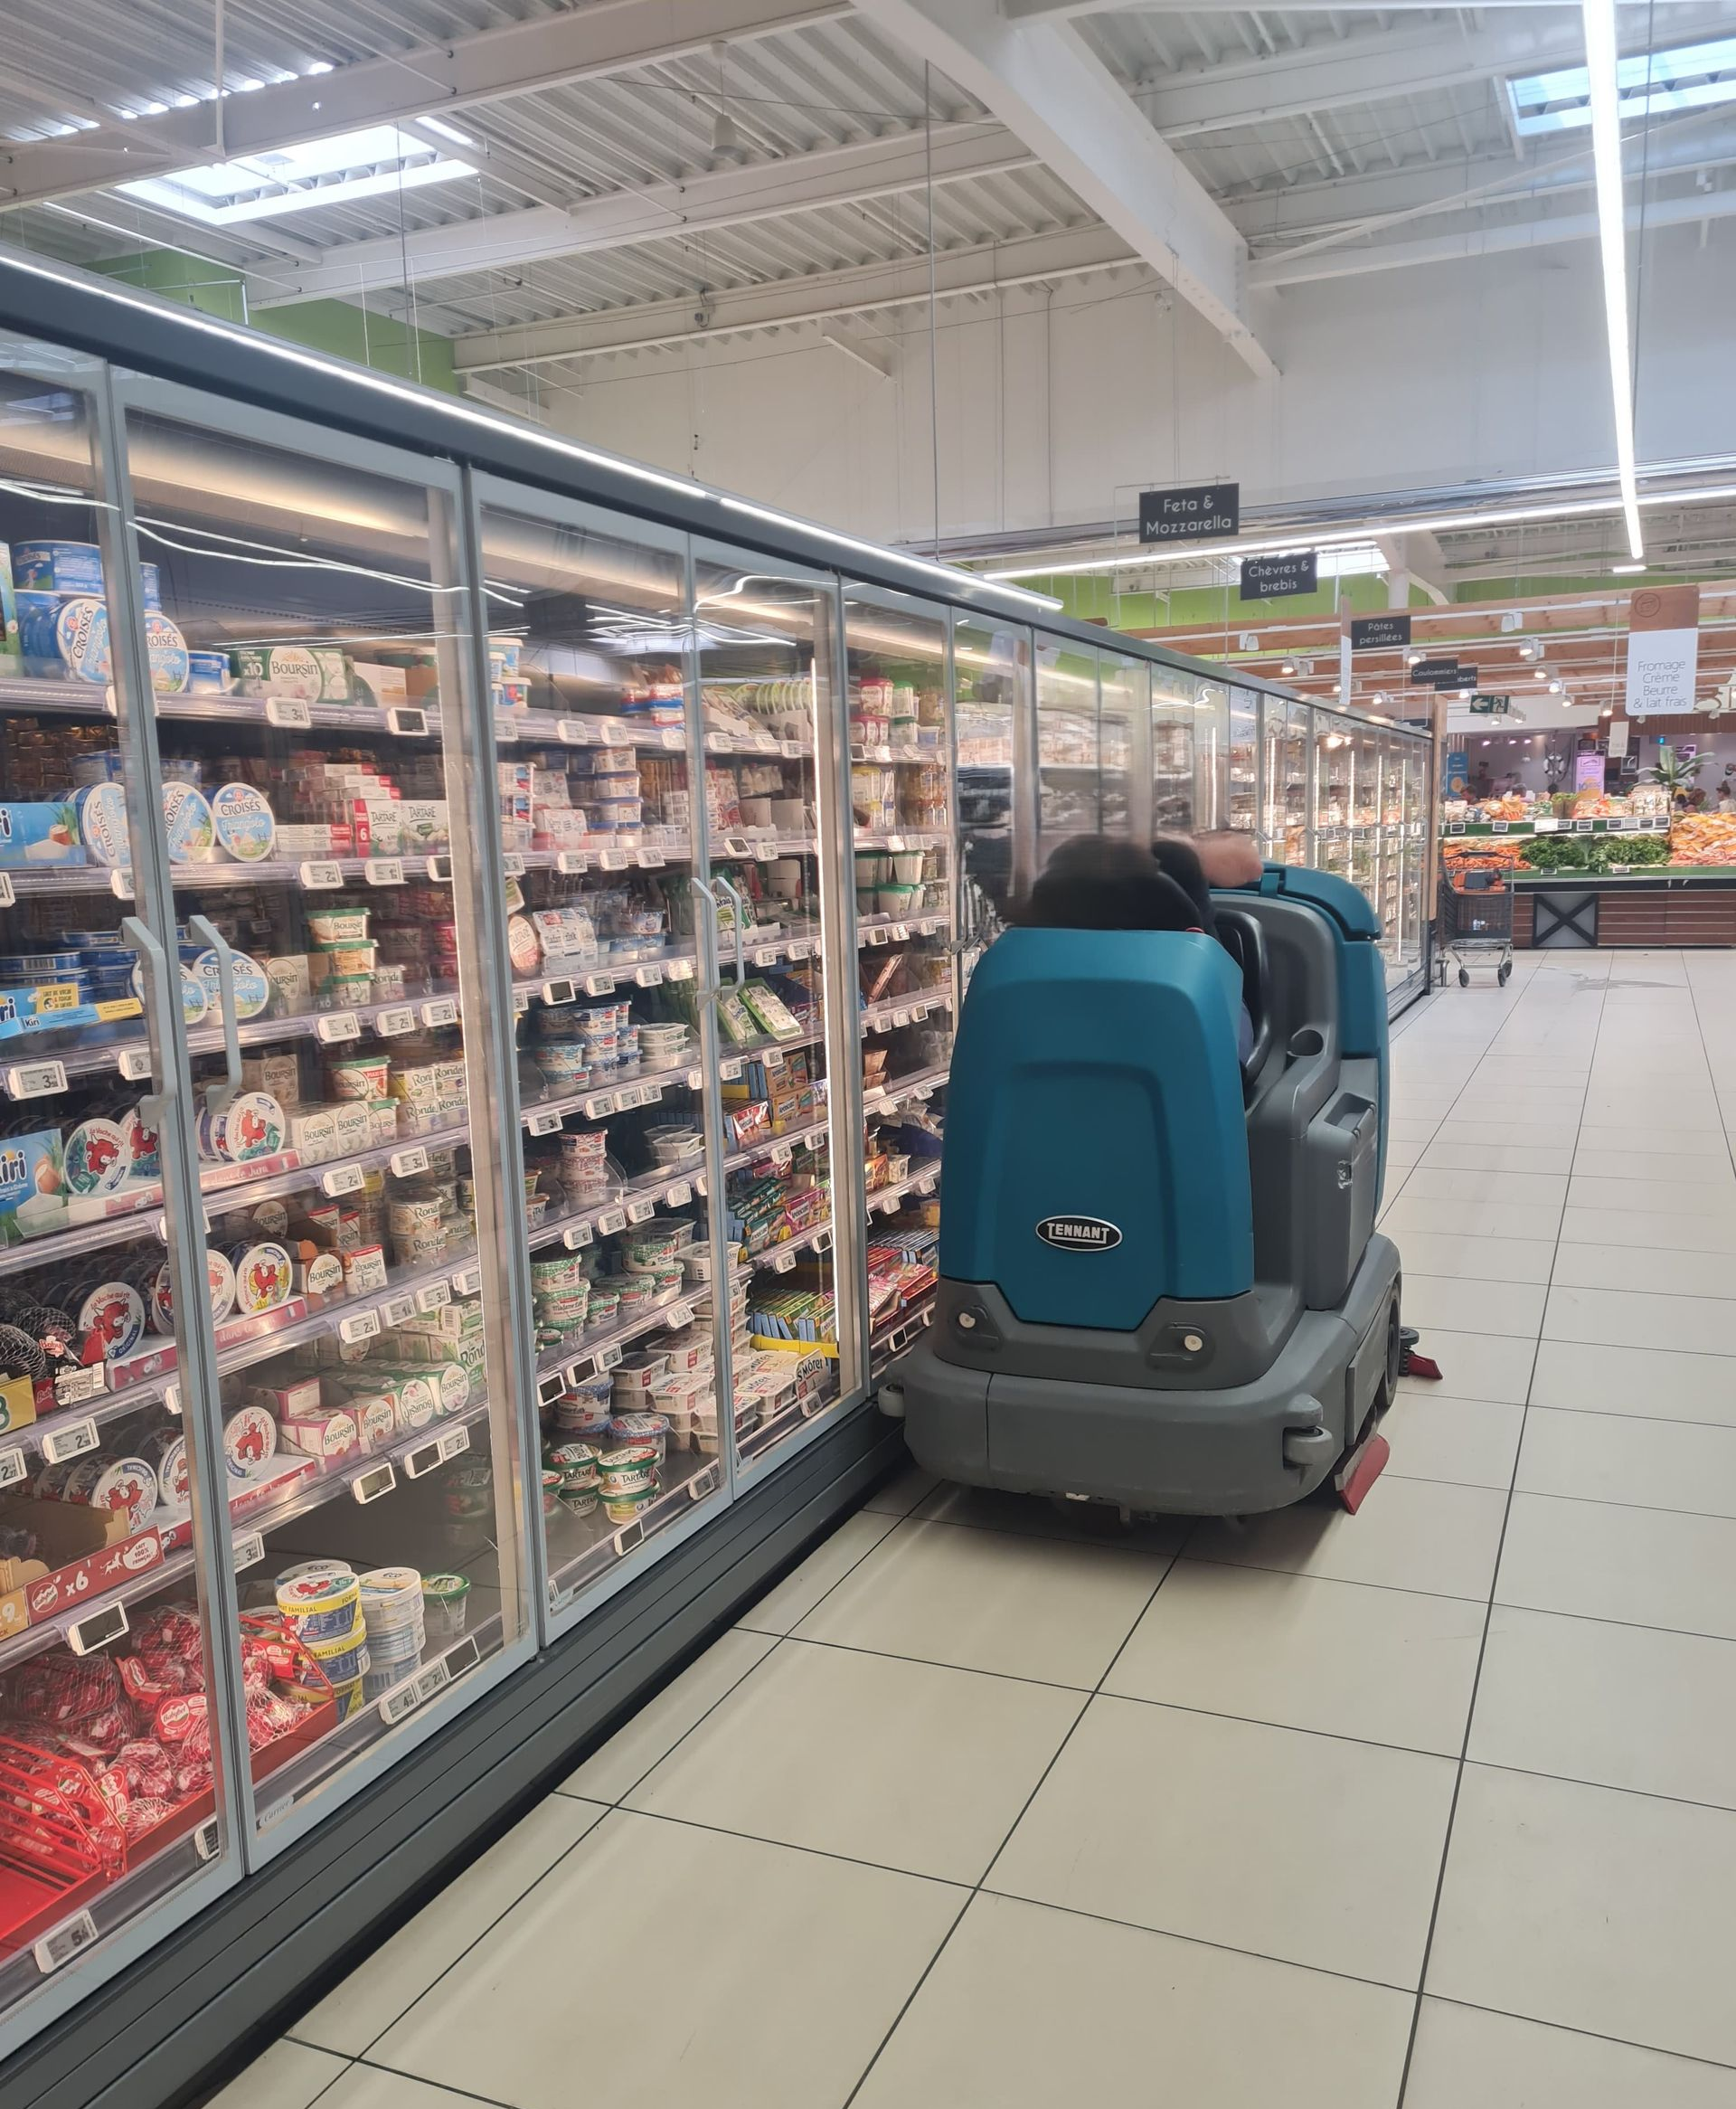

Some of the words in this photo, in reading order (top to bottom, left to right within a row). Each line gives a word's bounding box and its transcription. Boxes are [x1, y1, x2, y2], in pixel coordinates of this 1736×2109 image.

[1164, 498, 1197, 514] Feta
[1203, 495, 1213, 509] &
[1146, 515, 1231, 535] Mozzarella
[1249, 563, 1297, 578] Chèvres
[1300, 560, 1309, 572] &
[1260, 579, 1297, 593] brebis
[73, 607, 94, 659] CROISÉS
[1368, 621, 1394, 631] Pâtes
[146, 633, 177, 648] ROISÉS
[1359, 633, 1402, 646] persillées
[1637, 660, 1686, 673] Fromage
[1642, 672, 1680, 684] Crème
[1643, 685, 1678, 696] Beurre
[1633, 698, 1642, 709] &
[1646, 697, 1662, 708] lait
[1665, 695, 1687, 707] frais
[167, 790, 184, 834] ROISÉS
[221, 799, 260, 816] CROISÉS
[360, 828, 367, 841] 6
[203, 963, 253, 976] CRSÉS
[0, 998, 15, 1022] ri
[25, 1018, 40, 1028] Kiri
[96, 1127, 112, 1139] Vache
[0, 1151, 26, 1186] iri
[1047, 1223, 1109, 1244] TENNANT
[98, 1293, 114, 1304] Vache
[118, 1329, 138, 1354] ORIGINAL
[66, 1571, 89, 1596] x6
